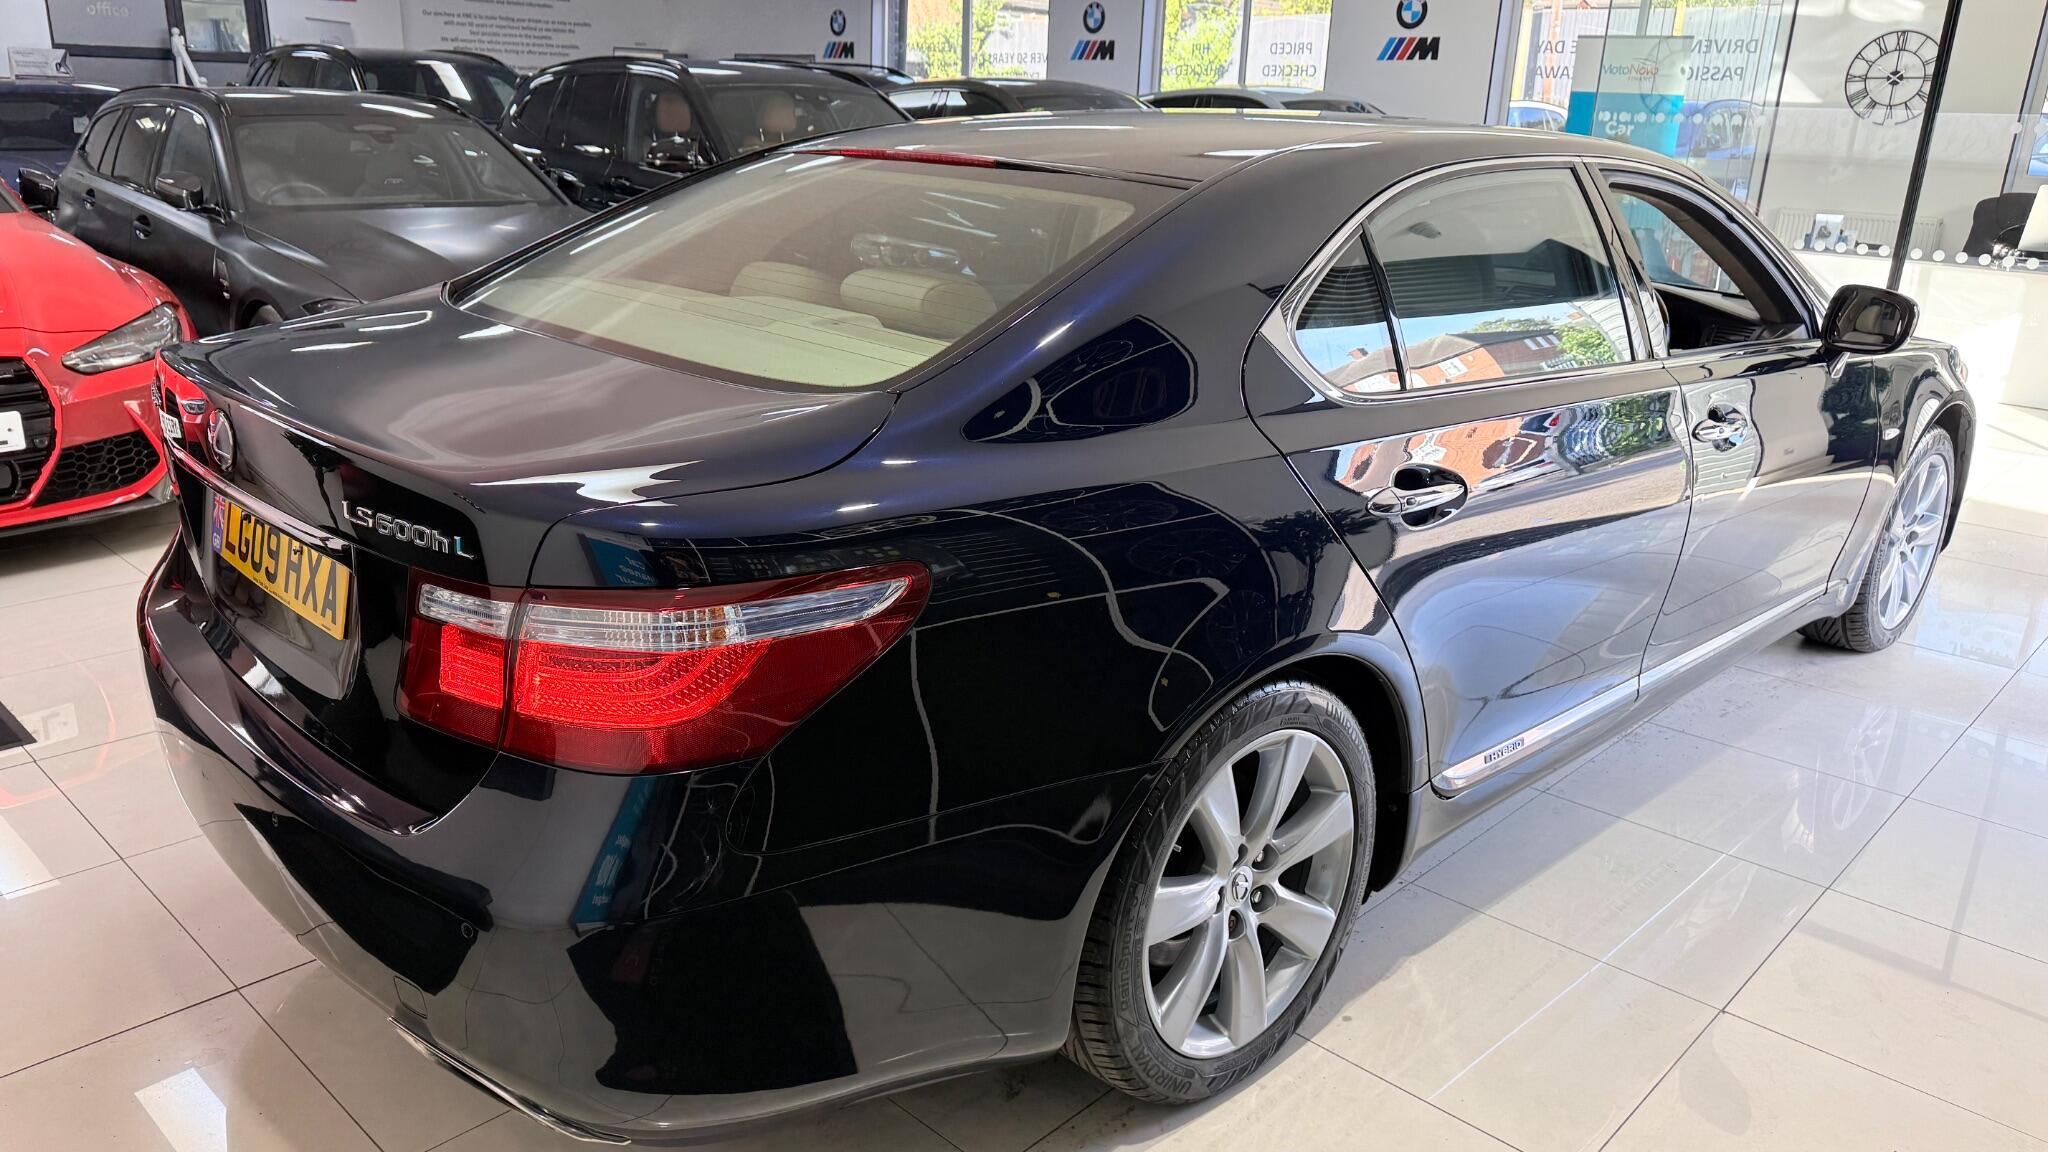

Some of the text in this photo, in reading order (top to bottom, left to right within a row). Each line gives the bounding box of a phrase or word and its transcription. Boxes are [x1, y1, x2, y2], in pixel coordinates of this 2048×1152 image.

[225, 502, 338, 626] LG09 HXA
[1490, 740, 1522, 761] HYBRID
